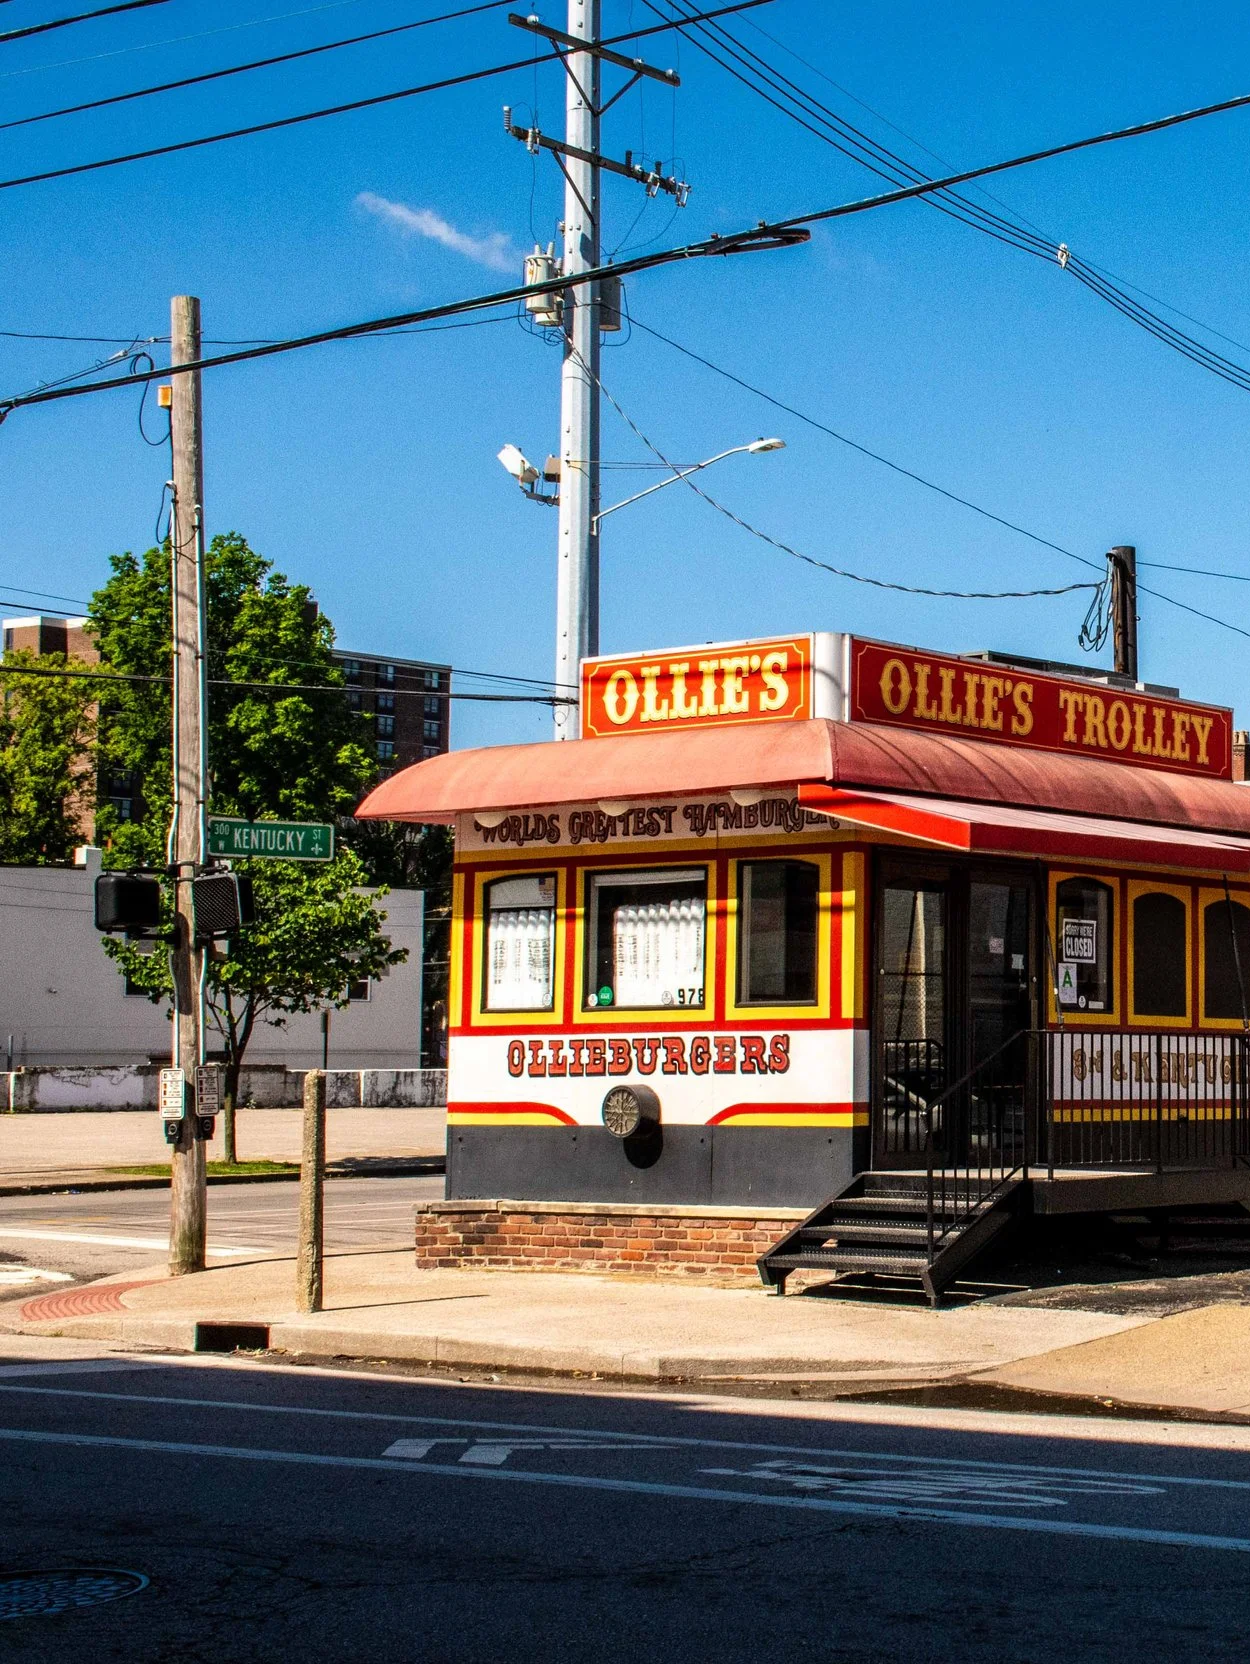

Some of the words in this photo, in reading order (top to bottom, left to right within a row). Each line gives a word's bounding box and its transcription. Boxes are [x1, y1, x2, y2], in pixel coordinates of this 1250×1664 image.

[602, 651, 789, 725] OLLIE'S
[879, 657, 1034, 738] OLLIE'S
[1058, 689, 1214, 766] TROLLEY
[214, 824, 230, 836] 300
[474, 812, 560, 847] WORLDS
[568, 805, 678, 845] GREATEST
[218, 841, 225, 851] W
[234, 828, 306, 852] KENTUCKY
[312, 829, 322, 840] ST
[1065, 924, 1080, 936] SORRY
[1065, 936, 1093, 957] CLOSED
[1062, 968, 1073, 987] A
[678, 988, 704, 1005] 978
[507, 1033, 791, 1079] OLLIEBURGERS
[1112, 1049, 1128, 1082] &
